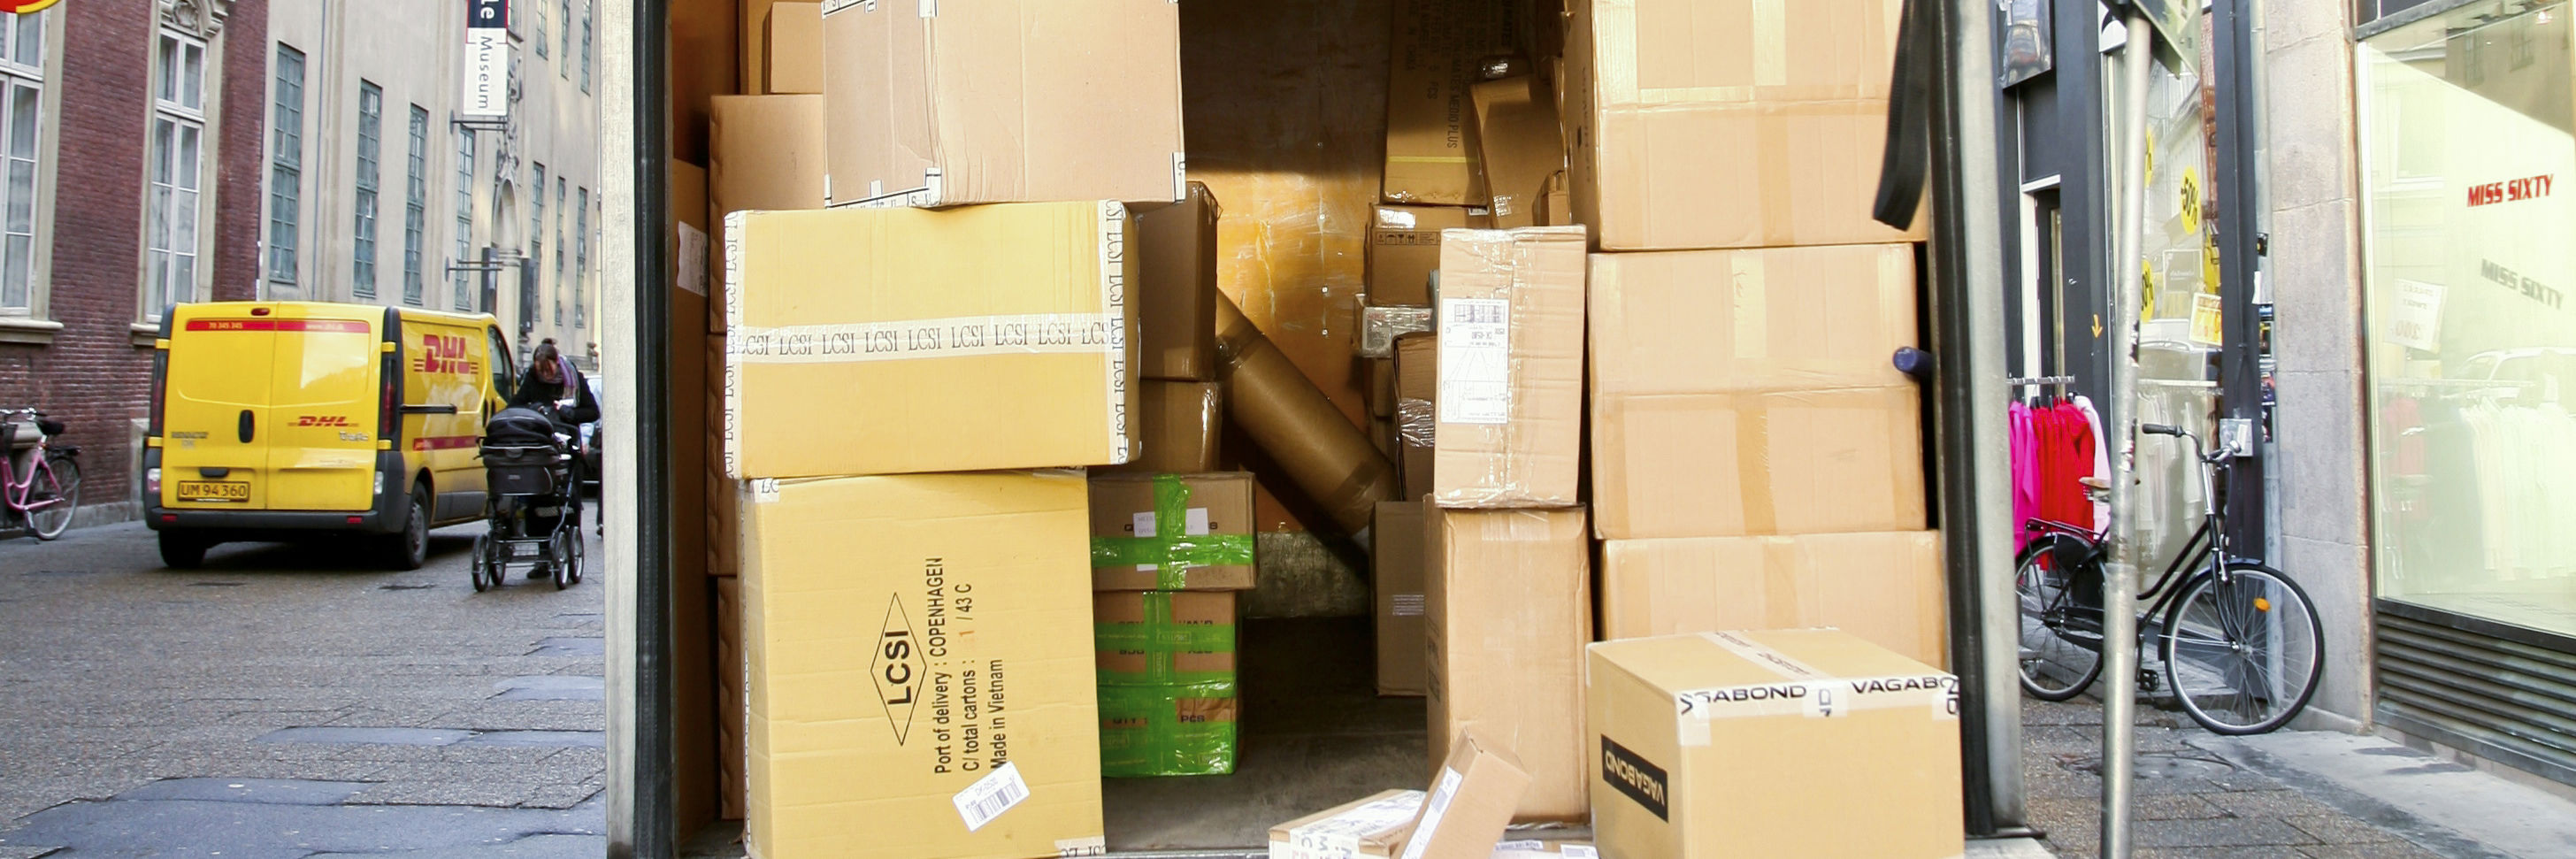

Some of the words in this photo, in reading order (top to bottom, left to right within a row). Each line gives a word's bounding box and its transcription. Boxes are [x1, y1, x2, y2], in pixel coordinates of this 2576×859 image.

[478, 36, 494, 109] Museum
[1448, 94, 1460, 123] MEDIO
[1446, 125, 1459, 149] PLUS
[2467, 182, 2503, 208] MISS
[2508, 173, 2554, 202] SIXTY
[2480, 258, 2518, 290] MISS
[2520, 277, 2564, 310] SIXTY
[423, 334, 471, 375] DHL
[778, 334, 813, 356] LCSI
[822, 333, 855, 355] LCSI
[864, 331, 900, 353] LCSI
[908, 327, 942, 351] LCSI
[951, 325, 985, 349] LCSI
[994, 324, 1029, 346] LCSI
[1039, 322, 1071, 345] LCSI
[1082, 321, 1111, 344] LCS
[297, 416, 350, 427] DHL
[180, 486, 201, 496] UM
[203, 486, 219, 496] 94
[220, 486, 248, 497] 360
[925, 557, 947, 657] COPENHAGEN
[954, 598, 973, 613] 43
[885, 630, 912, 705] LCSI
[932, 672, 953, 725] delivery
[960, 670, 978, 720] cartons
[987, 659, 1005, 714] Vietnam
[932, 728, 951, 742] of
[961, 725, 978, 755] total
[988, 717, 1006, 732] in
[934, 746, 952, 774] Port
[989, 733, 1008, 769] Made
[1604, 748, 1666, 808] VAGABOND
